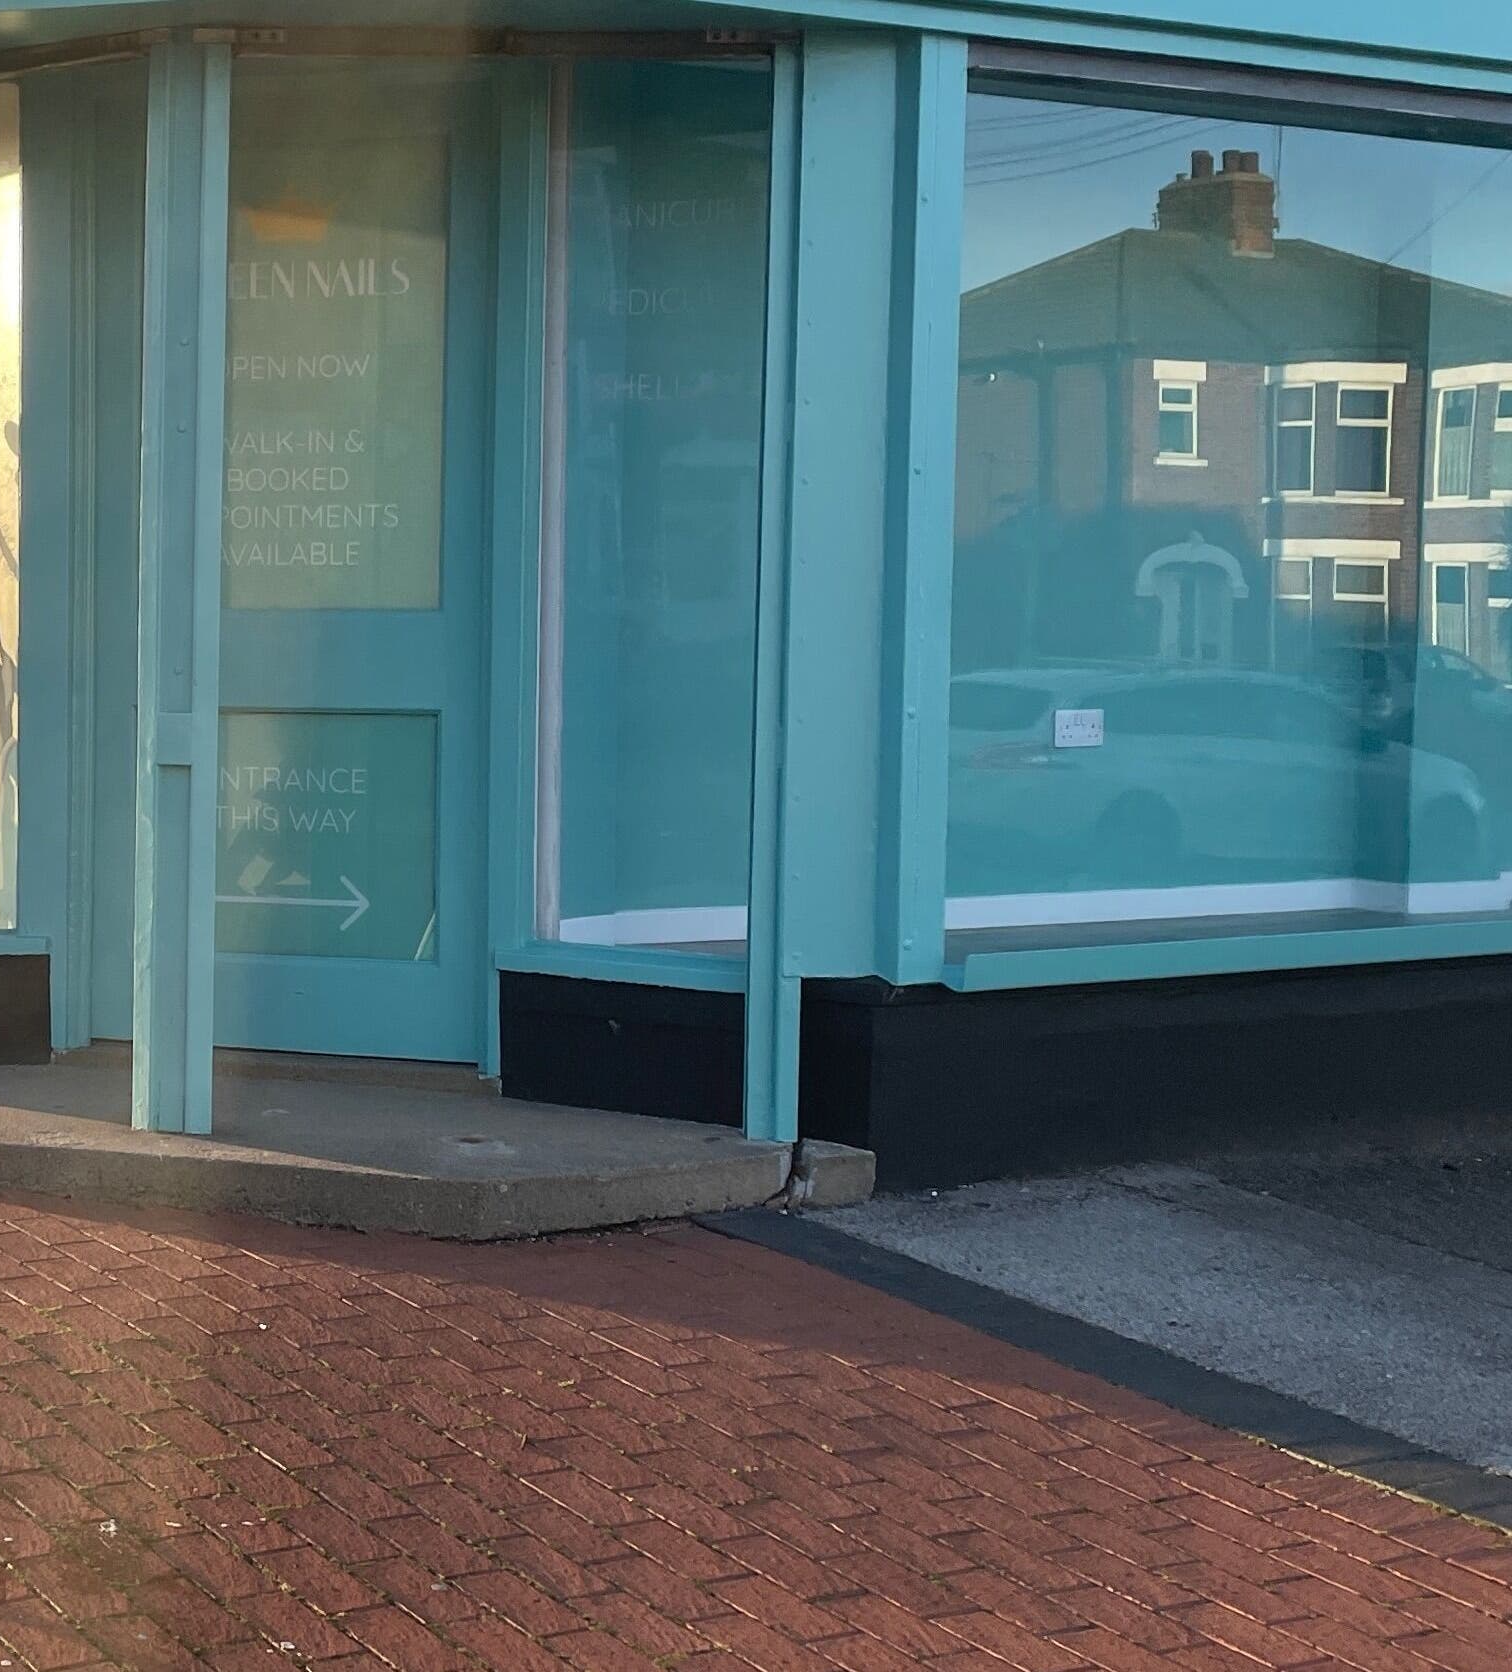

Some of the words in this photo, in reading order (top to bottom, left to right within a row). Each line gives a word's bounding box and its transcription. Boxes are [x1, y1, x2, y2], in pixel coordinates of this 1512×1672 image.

[227, 259, 296, 301] EEN
[306, 257, 411, 299] NAILS
[227, 354, 287, 381] PEN
[297, 353, 371, 379] NOW
[344, 428, 366, 454] &
[227, 466, 350, 492] BOOKED
[222, 503, 400, 529] OINTMENTS
[219, 766, 368, 794] NTRANCE
[216, 804, 280, 832] THIS
[288, 805, 357, 833] WAY
